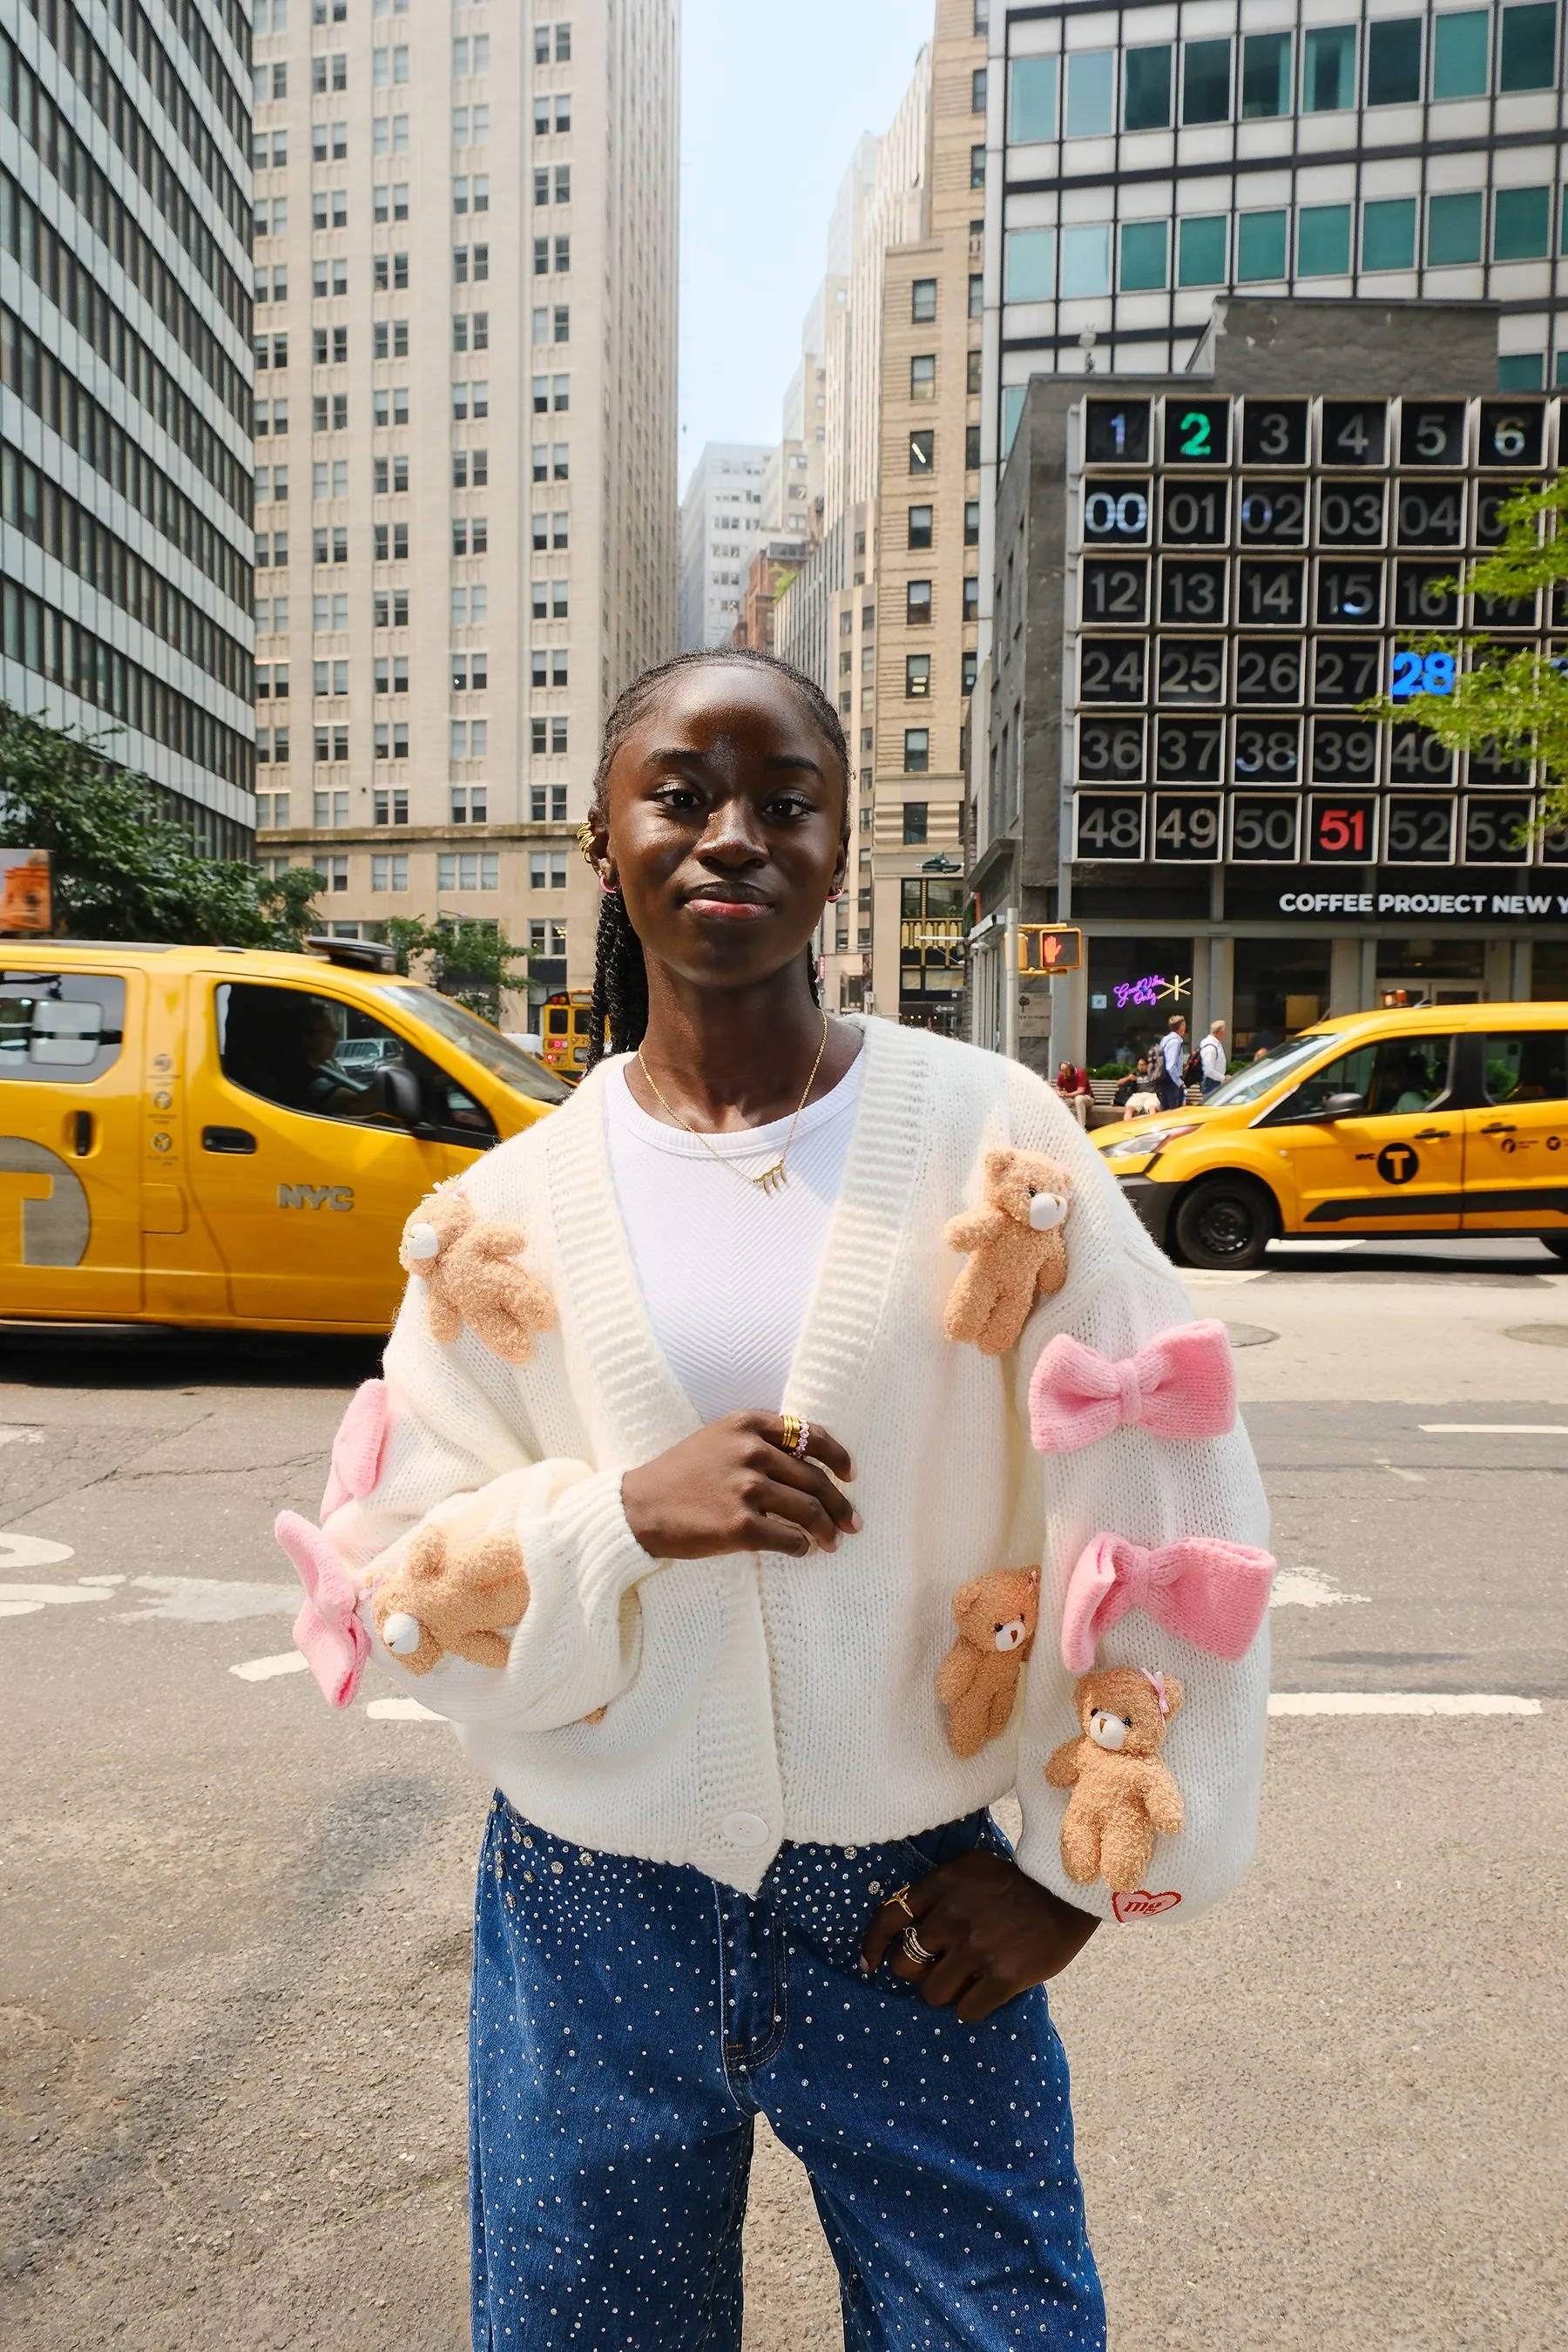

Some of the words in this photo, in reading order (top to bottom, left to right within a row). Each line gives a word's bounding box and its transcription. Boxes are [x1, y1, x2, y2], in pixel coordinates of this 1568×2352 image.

[1110, 413, 1125, 455] 1
[1180, 412, 1212, 456] 2
[1260, 414, 1289, 456] 3
[1338, 415, 1369, 456] 4
[1416, 416, 1447, 456] 5
[1493, 416, 1525, 457] 6
[1085, 492, 1149, 534] 00
[1168, 494, 1214, 535] 01
[1242, 495, 1304, 536] 02
[1321, 496, 1380, 537] 03
[1399, 496, 1459, 537] 04
[1091, 571, 1137, 612] 12
[1169, 572, 1215, 613] 13
[1247, 574, 1293, 614] 14
[1325, 574, 1374, 615] 15
[1404, 575, 1448, 617] 16
[1082, 652, 1142, 693] 24
[1160, 652, 1219, 693] 25
[1238, 653, 1299, 694] 26
[1317, 653, 1377, 694] 27
[1390, 652, 1455, 696] 28
[1081, 730, 1141, 770] 36
[1159, 730, 1220, 771] 37
[1235, 731, 1296, 772] 38
[1315, 732, 1374, 773] 39
[1390, 732, 1452, 773] 40
[1078, 808, 1139, 848] 48
[1156, 809, 1217, 848] 49
[1234, 809, 1295, 849] 50
[1319, 810, 1363, 851] 51
[1389, 811, 1450, 851] 52
[1467, 811, 1527, 852] 53
[1279, 893, 1374, 912] COFFEE
[1378, 894, 1488, 913] PROJECT
[1491, 895, 1552, 914] NEW
[1385, 1151, 1410, 1179] T
[277, 1182, 355, 1212] NYC
